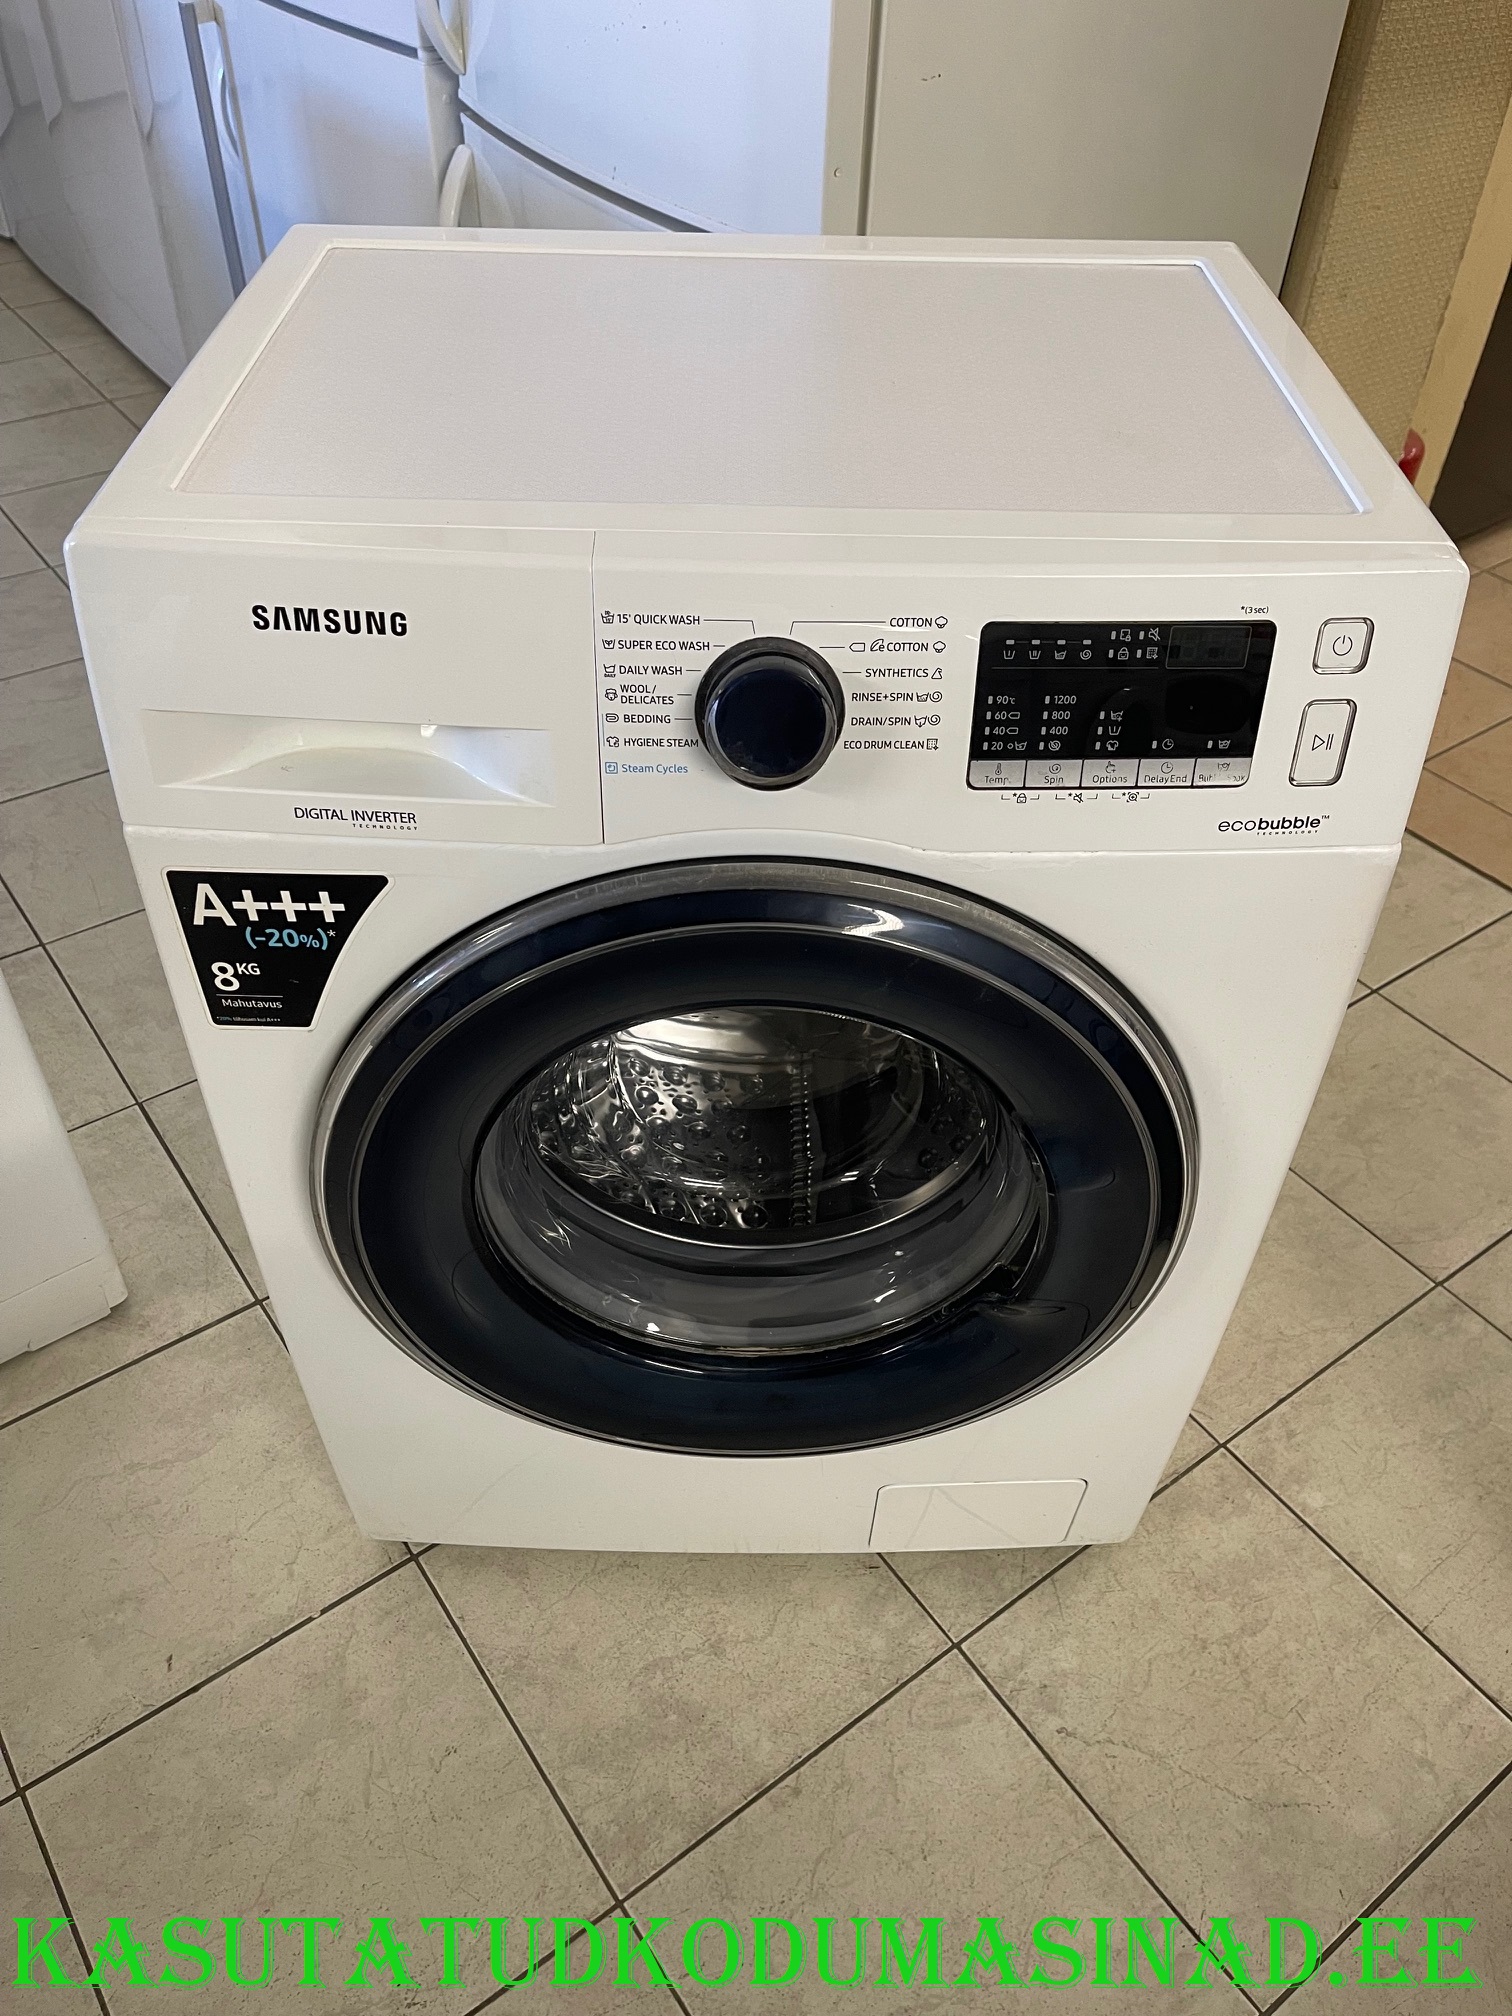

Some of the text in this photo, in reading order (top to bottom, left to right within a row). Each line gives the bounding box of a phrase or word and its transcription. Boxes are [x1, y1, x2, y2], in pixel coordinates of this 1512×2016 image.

[1254, 606, 1269, 614] sec)
[252, 604, 408, 637] SAMSUNG
[617, 614, 700, 625] 15' QUICK WASH
[890, 618, 933, 627] COTTON
[618, 640, 710, 651] SUPER ECO WASH
[619, 665, 683, 675] DAILY WASH
[865, 669, 929, 678] SYNTHETICS
[620, 685, 657, 694] WOOL/
[621, 695, 674, 705] DELICATES
[851, 692, 914, 702] RINSE+SPIN
[1054, 695, 1077, 704] 1200
[624, 714, 671, 723] BEDDING
[994, 711, 1007, 720] 60
[1051, 711, 1071, 720] 800
[851, 717, 911, 726] DRAIN/SPIN
[992, 726, 1006, 735] 40
[1049, 726, 1068, 735] 400
[624, 738, 699, 747] HYGIENE STEAM
[844, 740, 925, 749] ECO DRUM CLEAN
[991, 742, 1003, 751] 20
[622, 764, 688, 774] Steam Cycles
[1044, 775, 1064, 785] Spin
[1092, 774, 1128, 785] Options
[294, 807, 417, 823] DIGITAL INVERTER
[352, 823, 418, 831] TECHNOLOGY
[193, 883, 345, 926] A+++
[221, 998, 283, 1009] Mahutavus
